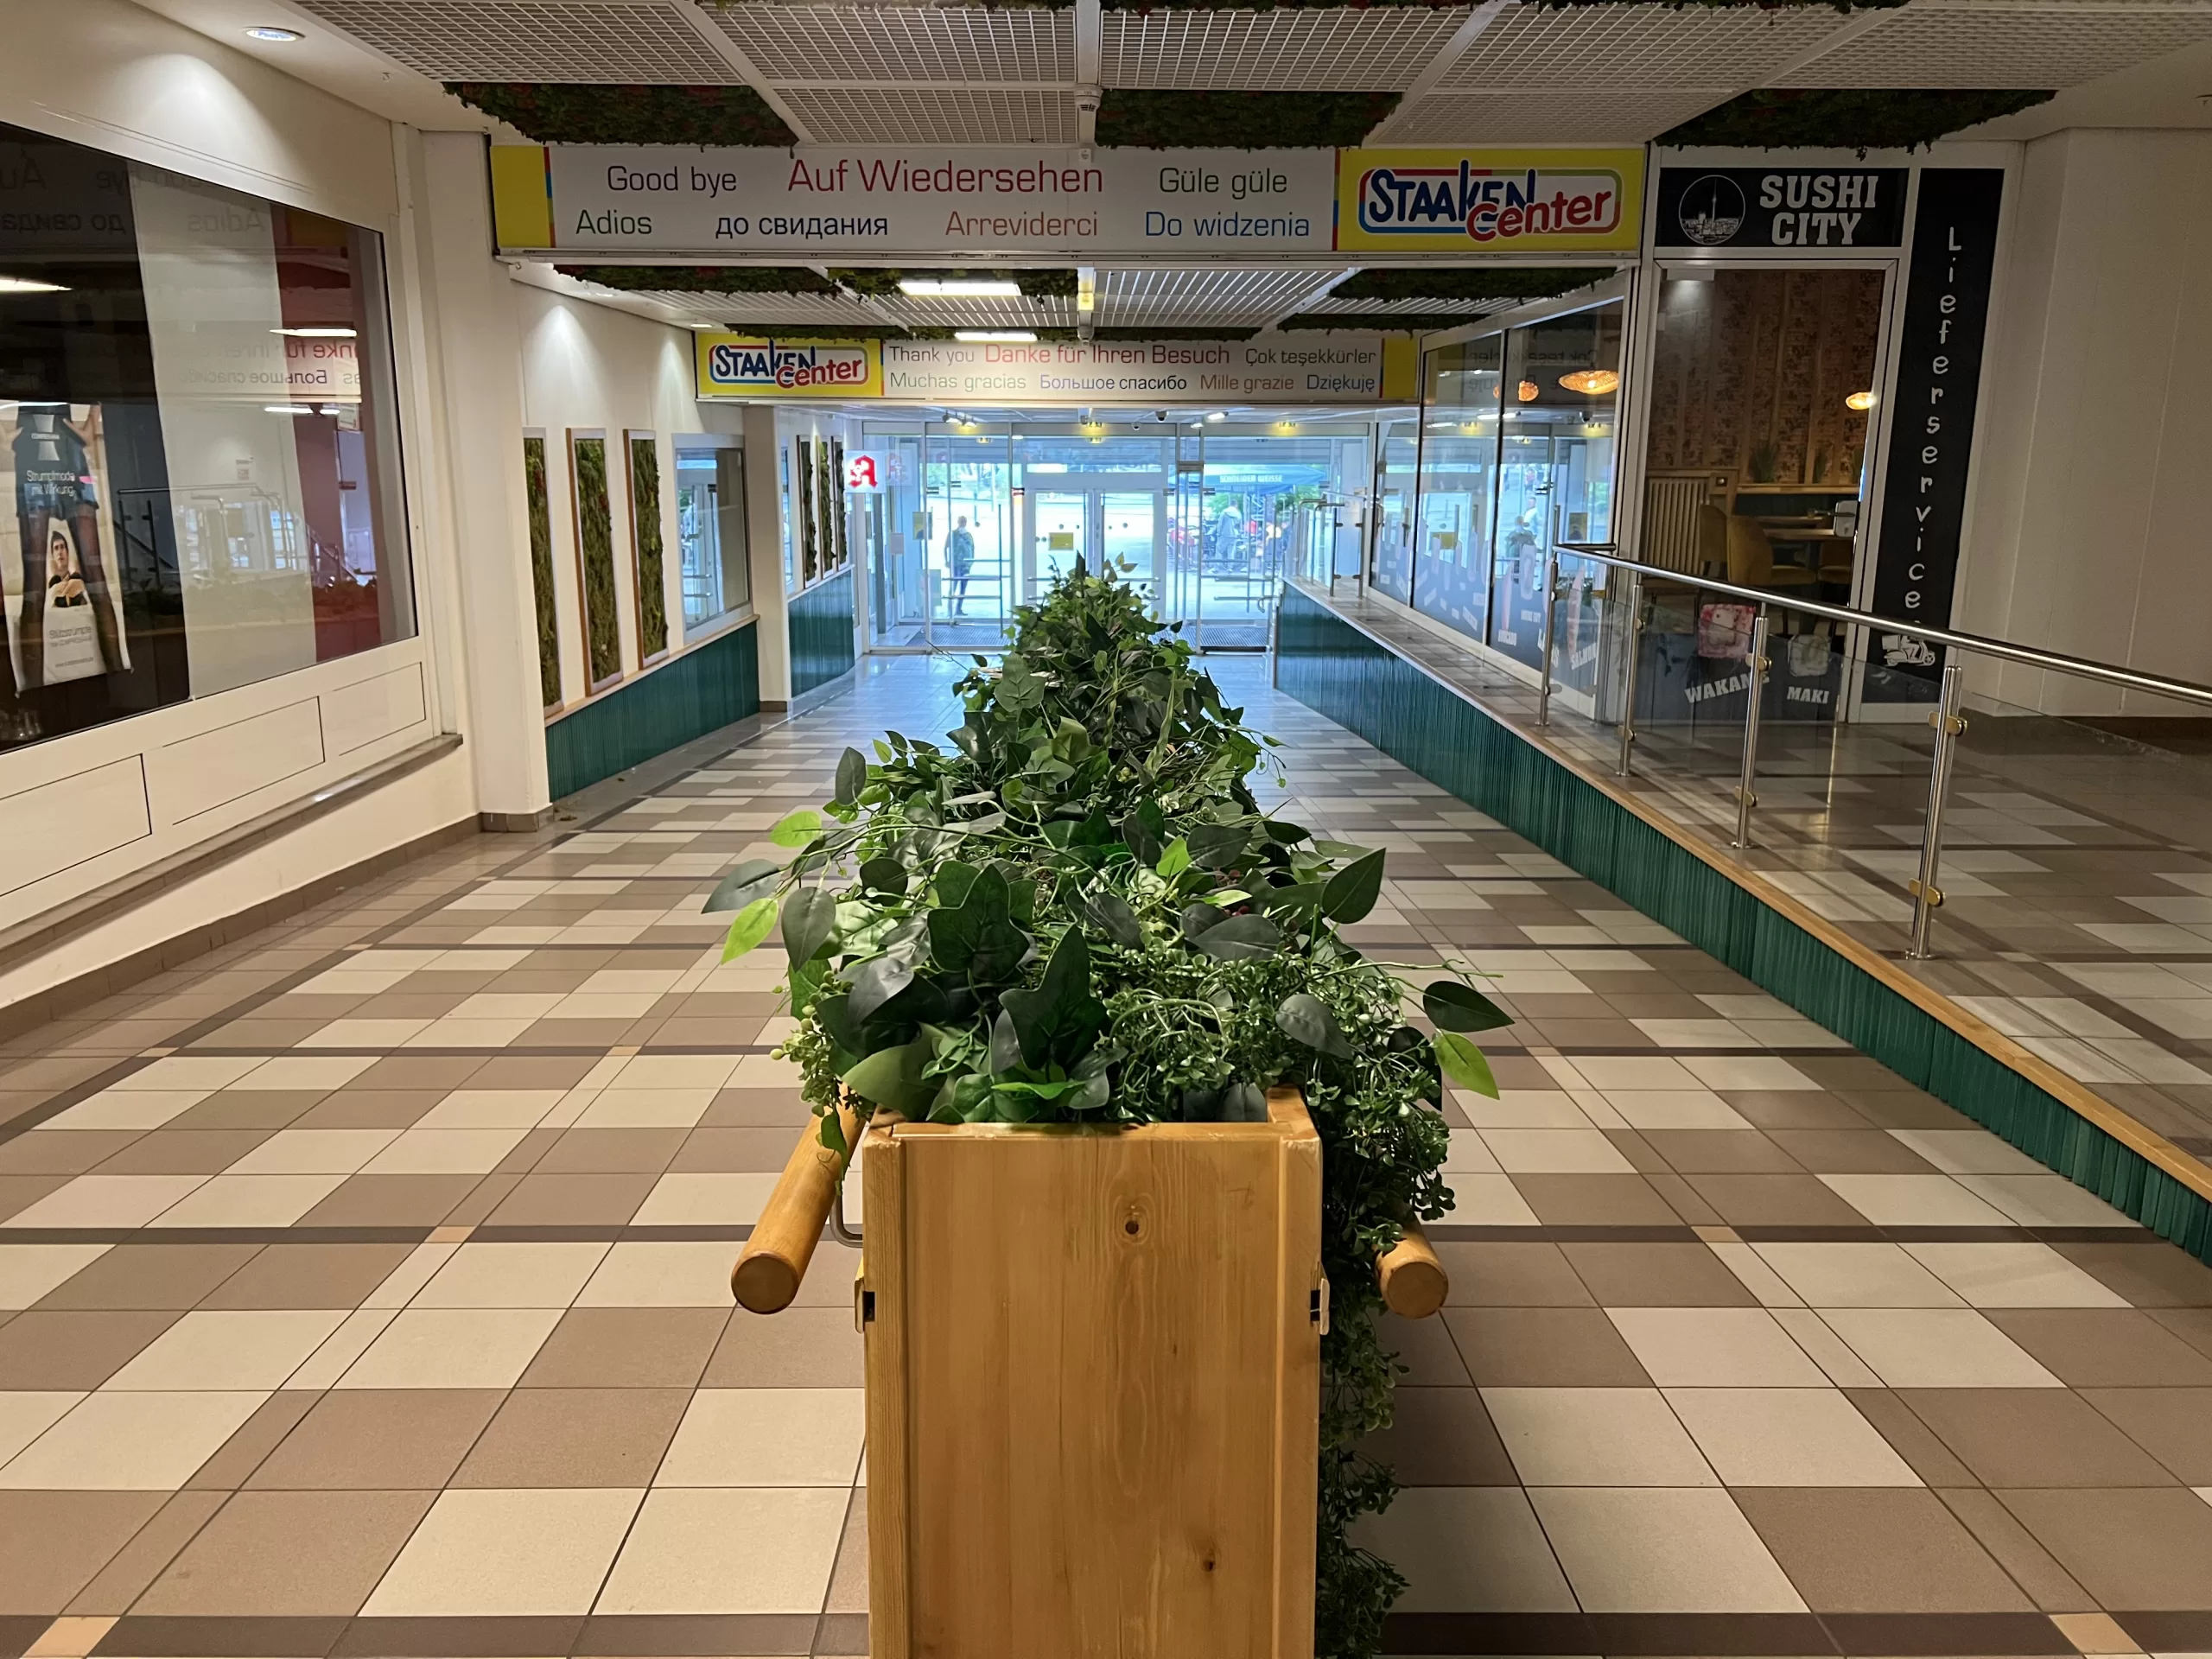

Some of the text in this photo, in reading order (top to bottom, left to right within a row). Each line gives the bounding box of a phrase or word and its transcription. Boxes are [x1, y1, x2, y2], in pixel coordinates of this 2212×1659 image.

[607, 165, 737, 197] Good bye
[787, 159, 1103, 193] Auf Wiedersehen
[1159, 167, 1287, 200] Güle güle
[1369, 159, 1536, 223] STAAKEN
[1759, 175, 1879, 209] SUSHI
[575, 209, 653, 235] Adios
[715, 217, 889, 239] до свидания
[945, 211, 1098, 237] Arreviderci
[1145, 211, 1310, 237] Do widzenia
[1466, 190, 1612, 242] Center
[1771, 212, 1862, 245] CITY
[715, 339, 816, 378] STAAKEN
[889, 346, 975, 366] Thank you
[985, 344, 1230, 364] Danke für Ihren Besuch
[1245, 347, 1376, 367] Çok teşekkürler
[776, 358, 862, 389] Center
[889, 372, 1027, 391] Muchas gracias
[1039, 373, 1187, 391] Большое спасибо
[1200, 374, 1294, 394] Mille grazie
[1306, 374, 1376, 394] Dziękuję
[1904, 226, 1962, 608] Lieferservice
[1786, 685, 1830, 704] MAKI
